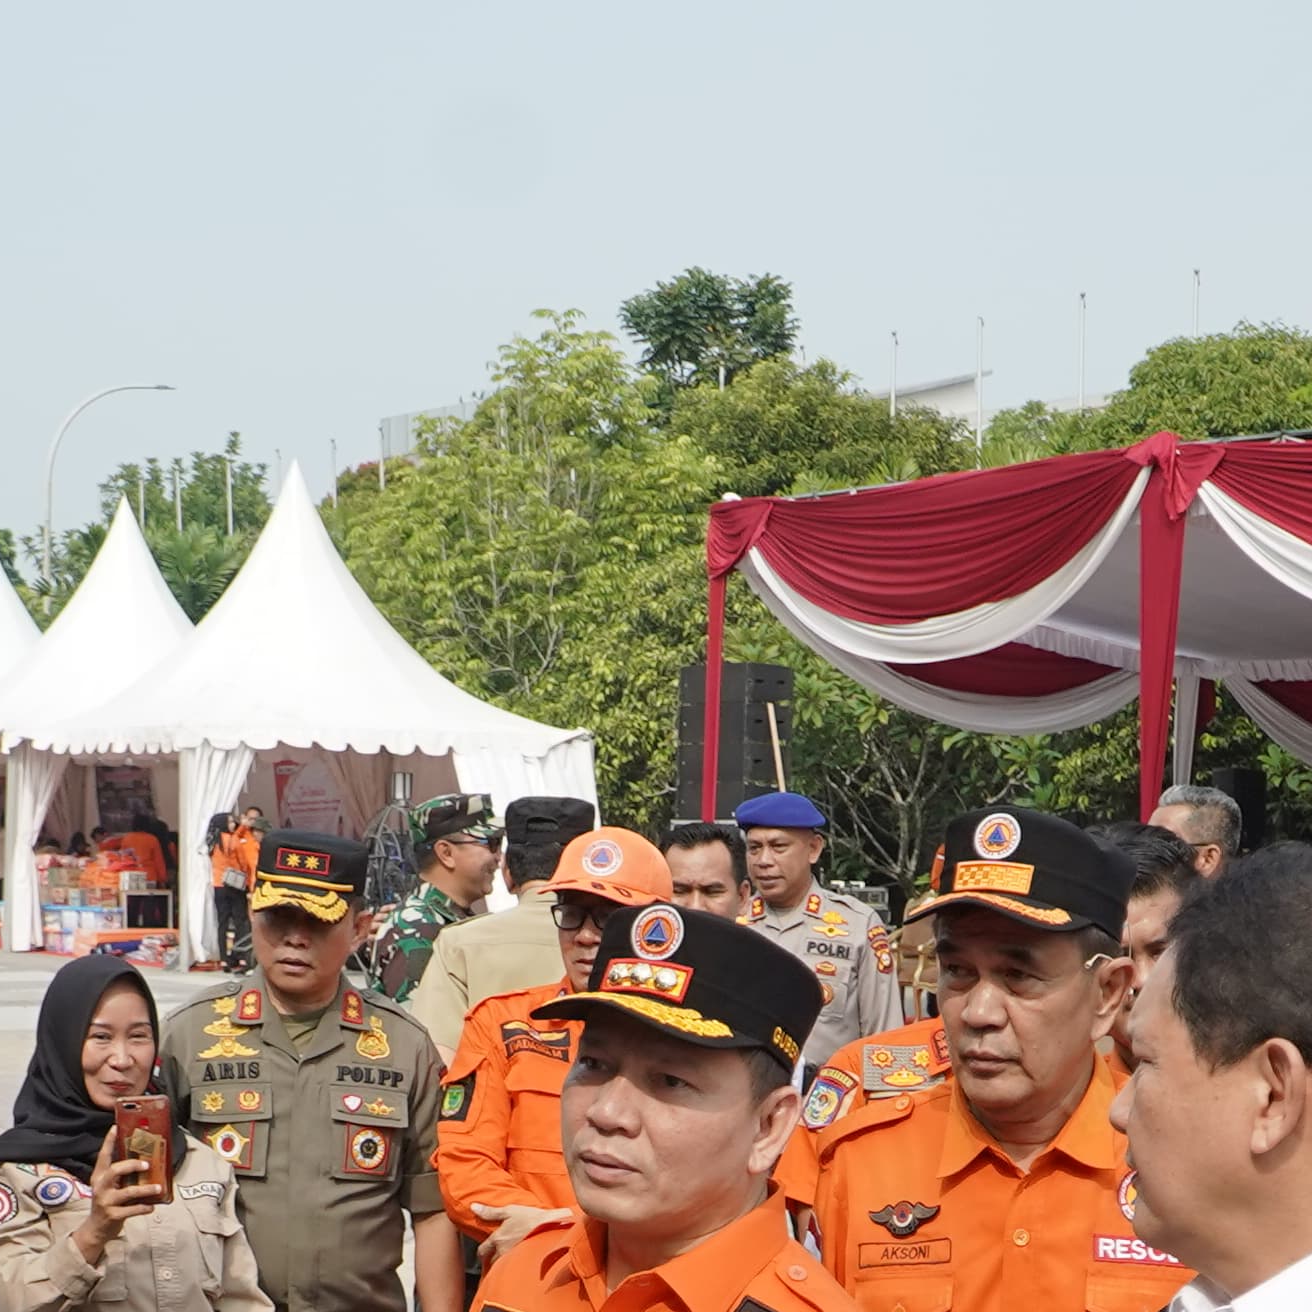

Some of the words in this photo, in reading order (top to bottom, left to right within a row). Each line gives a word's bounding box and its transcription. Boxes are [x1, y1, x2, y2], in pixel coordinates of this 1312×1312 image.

[807, 941, 850, 960] POLRI
[203, 1061, 260, 1082] ARIS
[881, 1245, 930, 1260] AKSONI
